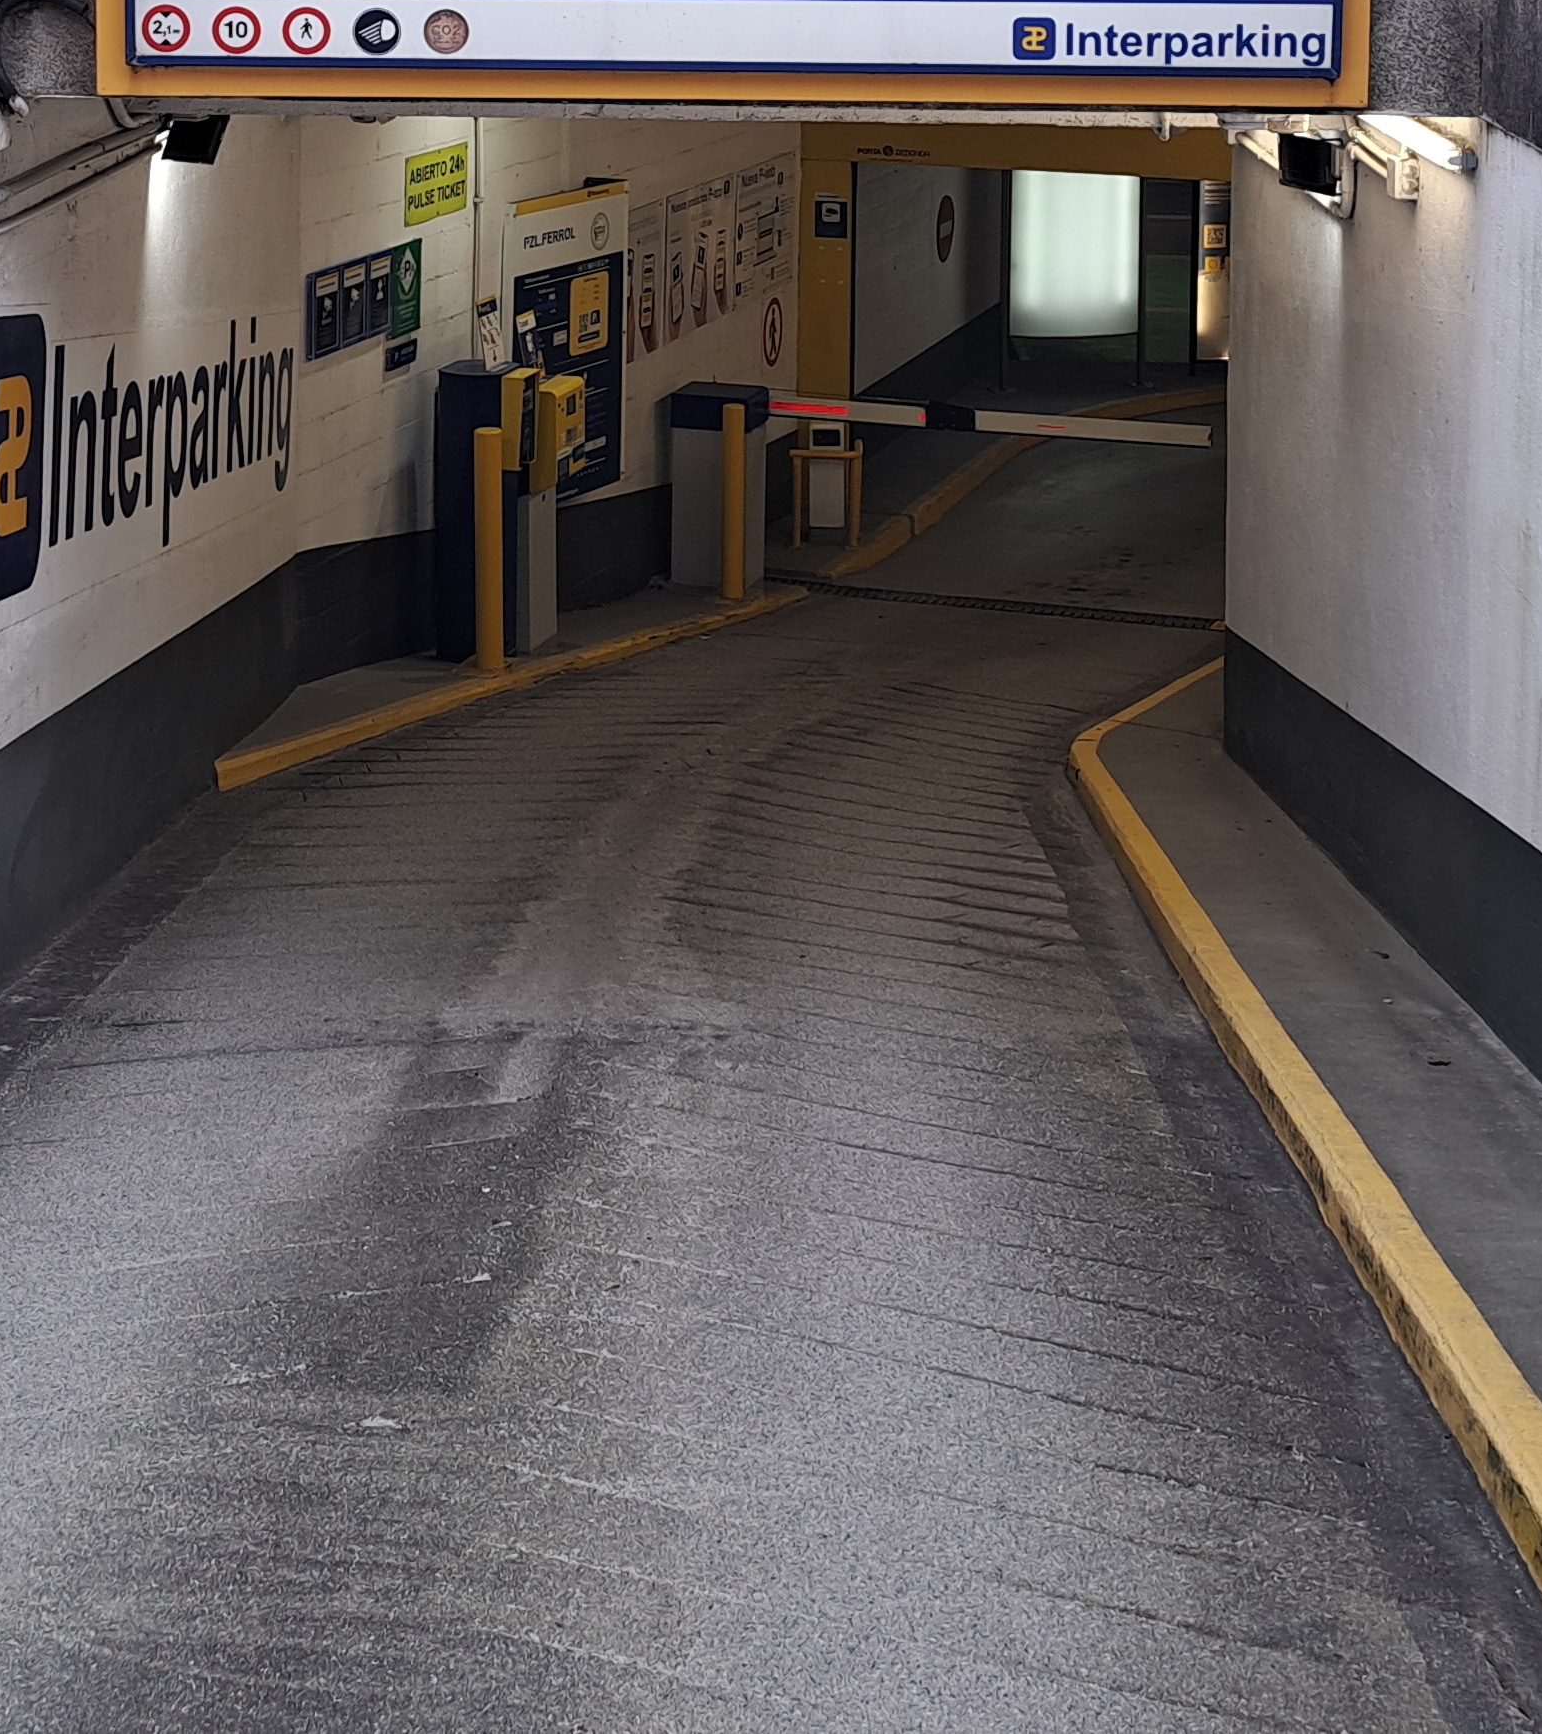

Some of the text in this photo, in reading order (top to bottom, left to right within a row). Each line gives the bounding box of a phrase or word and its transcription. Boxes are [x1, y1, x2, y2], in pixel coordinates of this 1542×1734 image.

[223, 20, 248, 39] 10
[1065, 22, 1327, 67] Interparking
[409, 153, 465, 186] ABIERTO 24h
[407, 179, 466, 212] PULSE TICKET
[48, 316, 294, 548] Interparking
